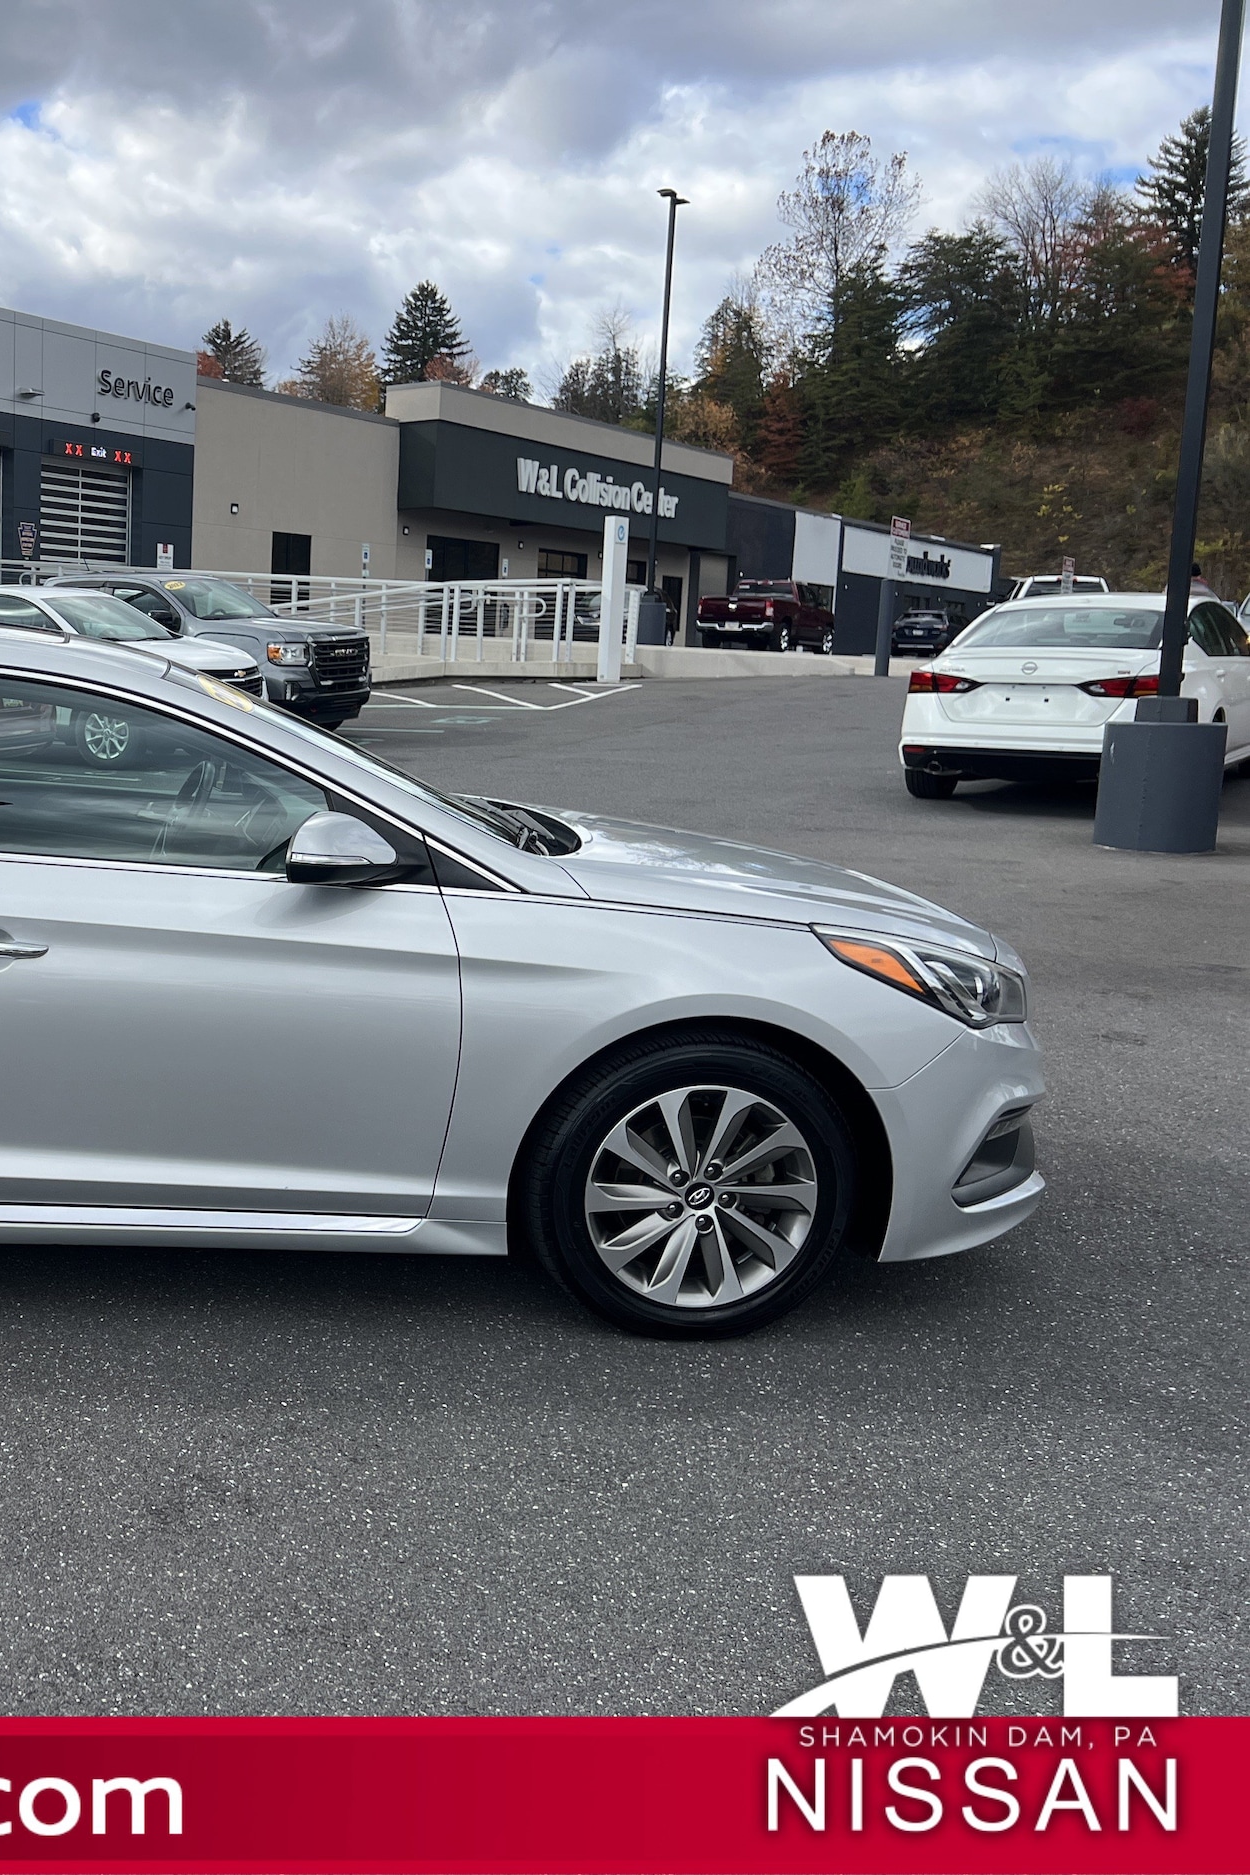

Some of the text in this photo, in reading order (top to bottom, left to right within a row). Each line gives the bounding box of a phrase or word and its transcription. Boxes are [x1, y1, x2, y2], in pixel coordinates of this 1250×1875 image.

[98, 369, 174, 407] Service
[91, 446, 107, 459] Exit
[517, 457, 679, 518] W&L Collision Ceter
